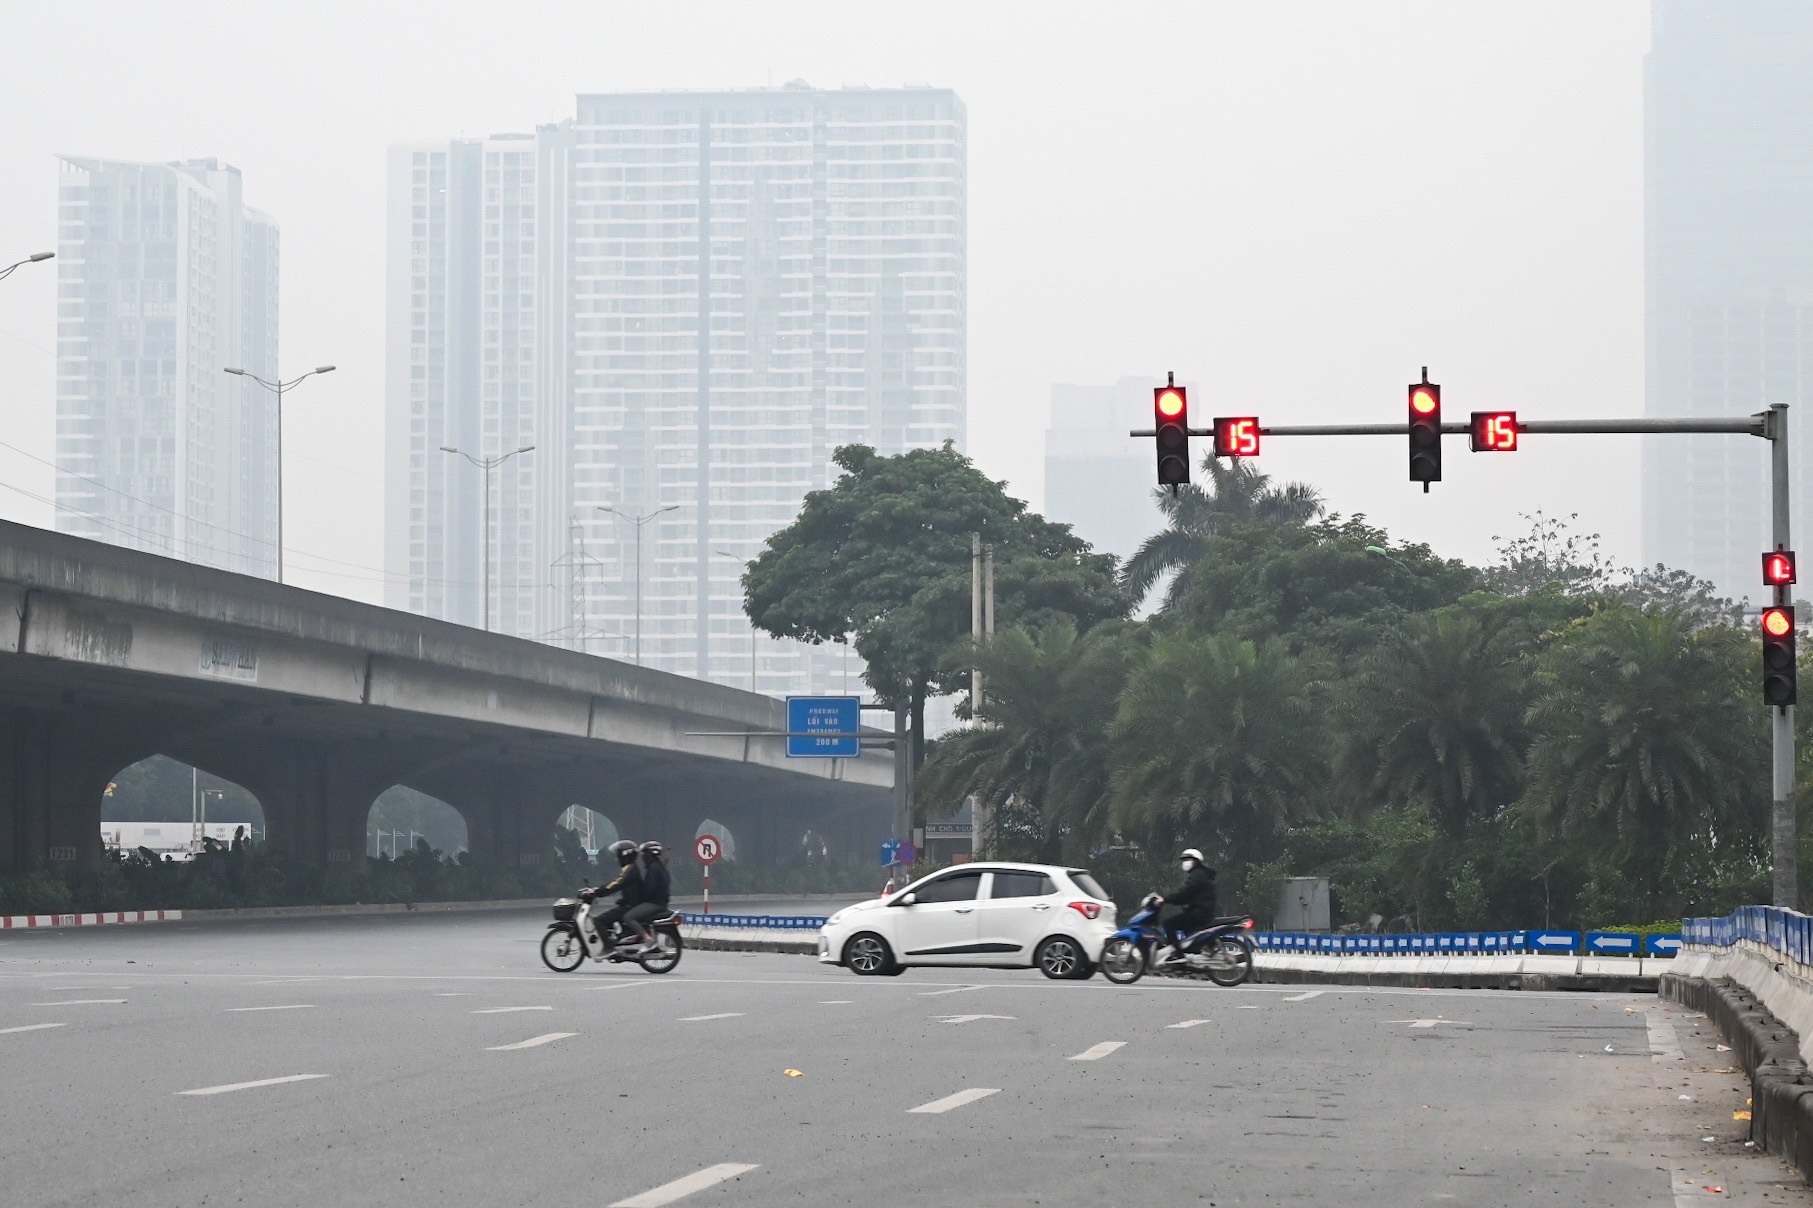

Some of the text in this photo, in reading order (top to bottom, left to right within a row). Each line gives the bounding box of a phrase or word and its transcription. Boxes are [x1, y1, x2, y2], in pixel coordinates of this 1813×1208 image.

[1230, 421, 1257, 452] 15
[1487, 415, 1514, 447] 15
[816, 738, 830, 746] 200
